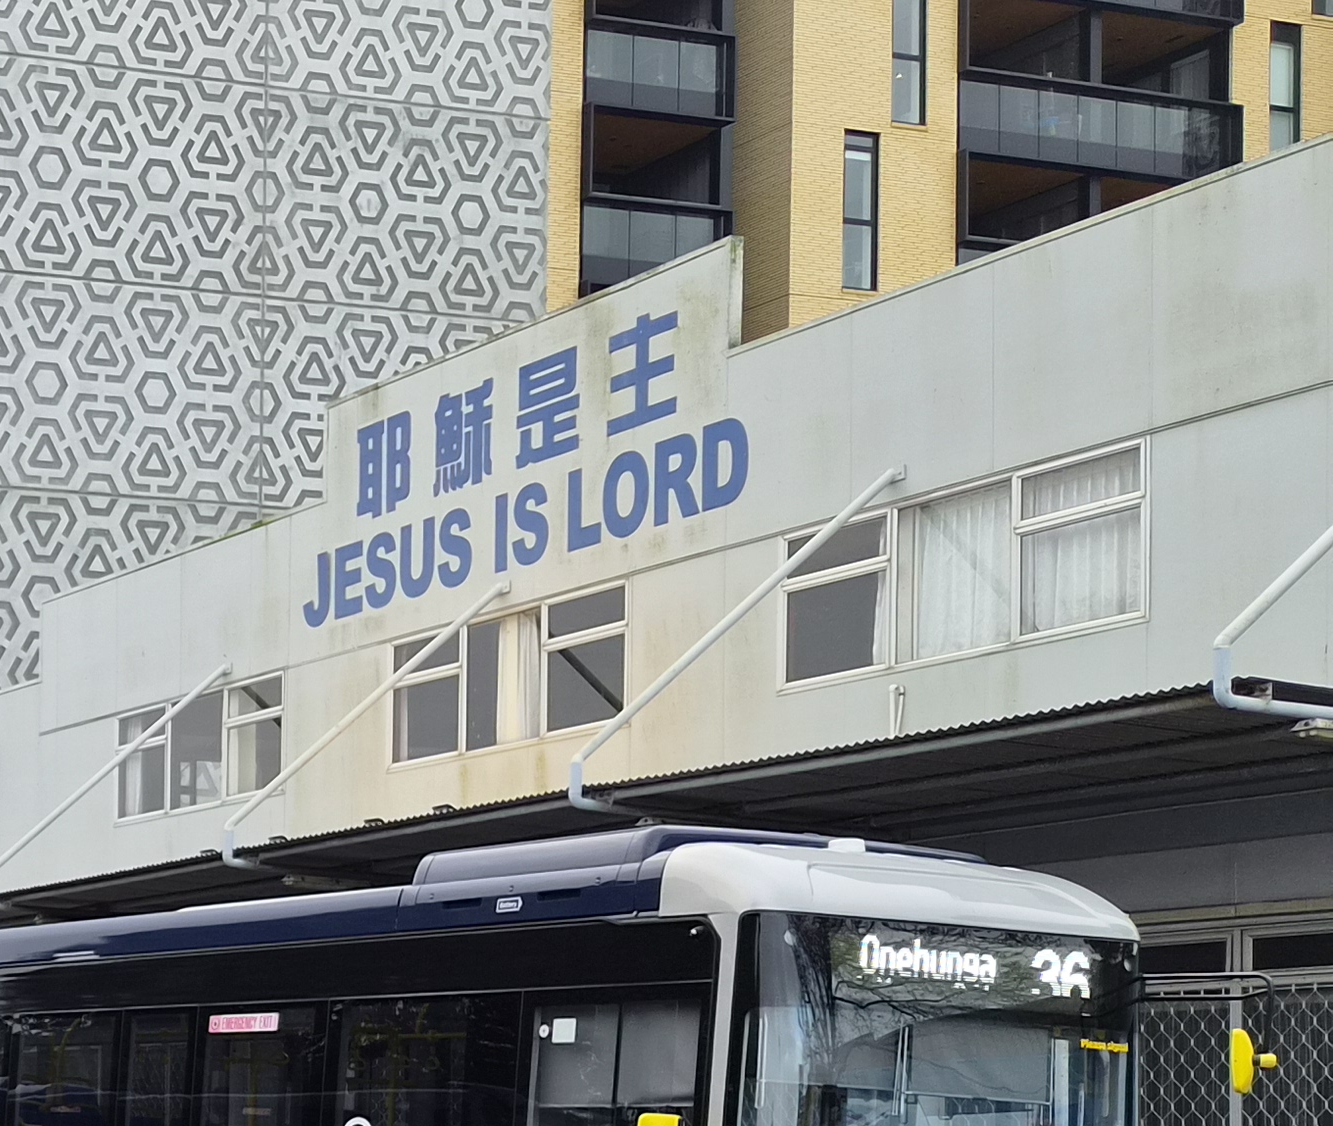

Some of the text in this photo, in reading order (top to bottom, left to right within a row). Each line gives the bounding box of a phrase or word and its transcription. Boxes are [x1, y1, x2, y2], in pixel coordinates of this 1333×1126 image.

[355, 310, 679, 519] 耶穌是主
[301, 417, 750, 629] JESUS IS LORD
[222, 1015, 273, 1030] EMERGENCY EXIT
[858, 932, 1091, 999] Onehunga 36
